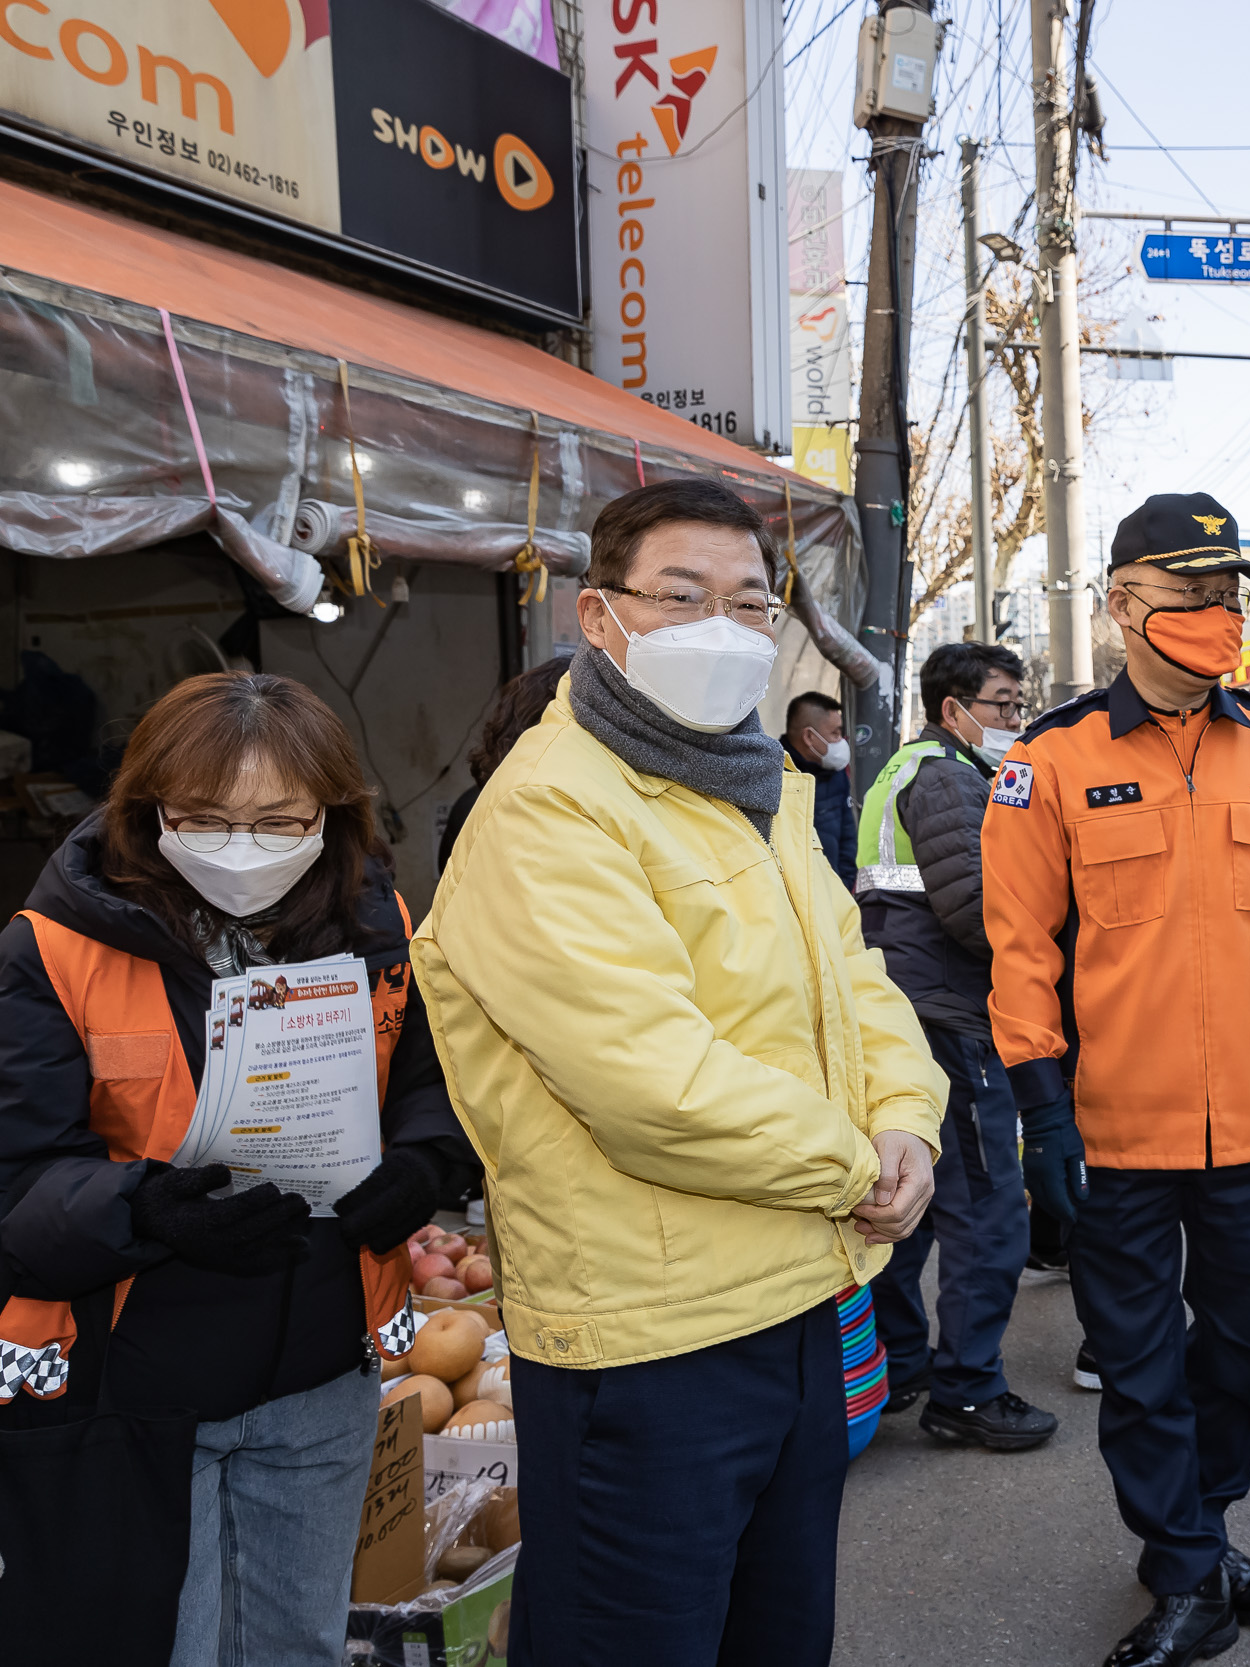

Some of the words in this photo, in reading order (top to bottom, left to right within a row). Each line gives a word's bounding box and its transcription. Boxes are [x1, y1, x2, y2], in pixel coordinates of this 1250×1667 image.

[613, 0, 659, 100] SK
[107, 110, 201, 164] 우인정보
[208, 149, 299, 200] 02)462-1816
[371, 107, 486, 184] SHOW
[616, 131, 655, 390] telecom
[806, 346, 831, 415] world
[993, 794, 1024, 807] KOREA
[286, 1013, 314, 1029] 소방차
[316, 1012, 324, 1026] 길
[325, 1008, 346, 1025] 터주기
